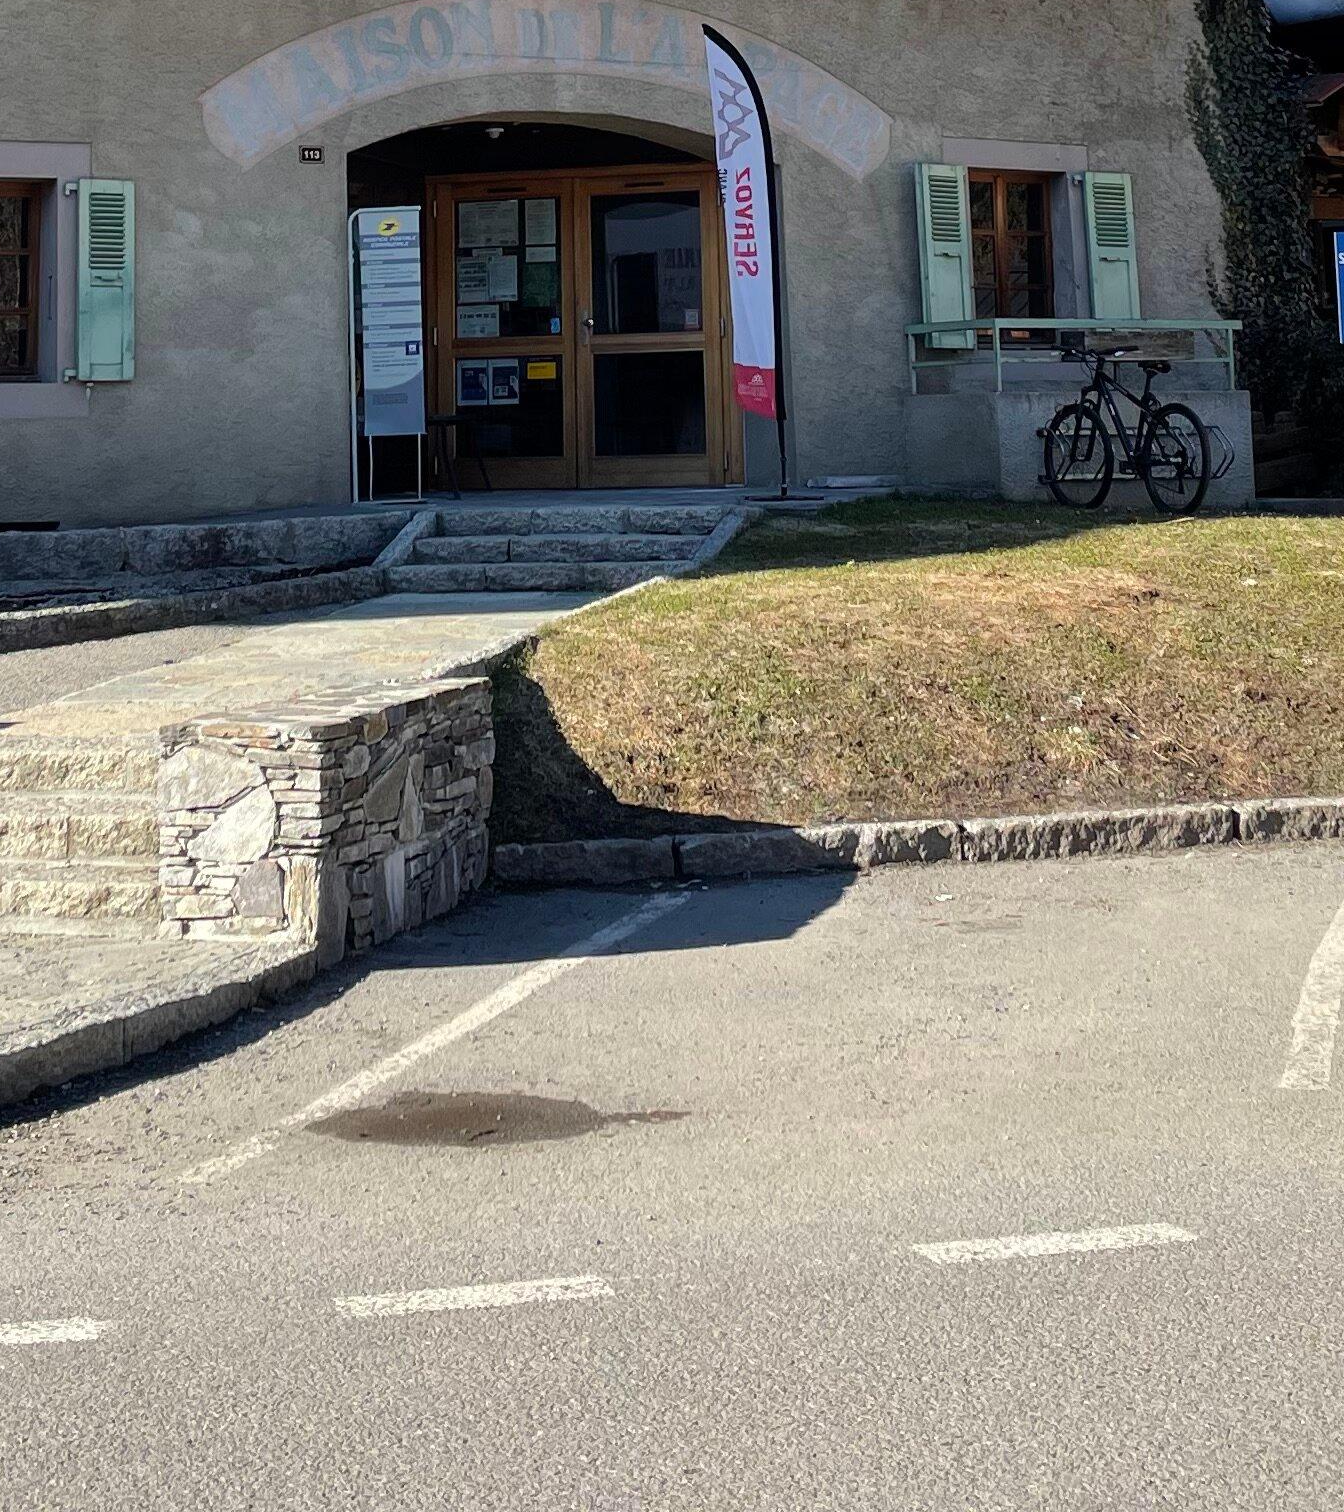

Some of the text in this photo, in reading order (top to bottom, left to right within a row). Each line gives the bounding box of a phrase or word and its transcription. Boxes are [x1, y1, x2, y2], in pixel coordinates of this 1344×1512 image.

[513, 7, 581, 67] DE
[596, 1, 885, 169] L'APAGE
[305, 150, 320, 159] 113
